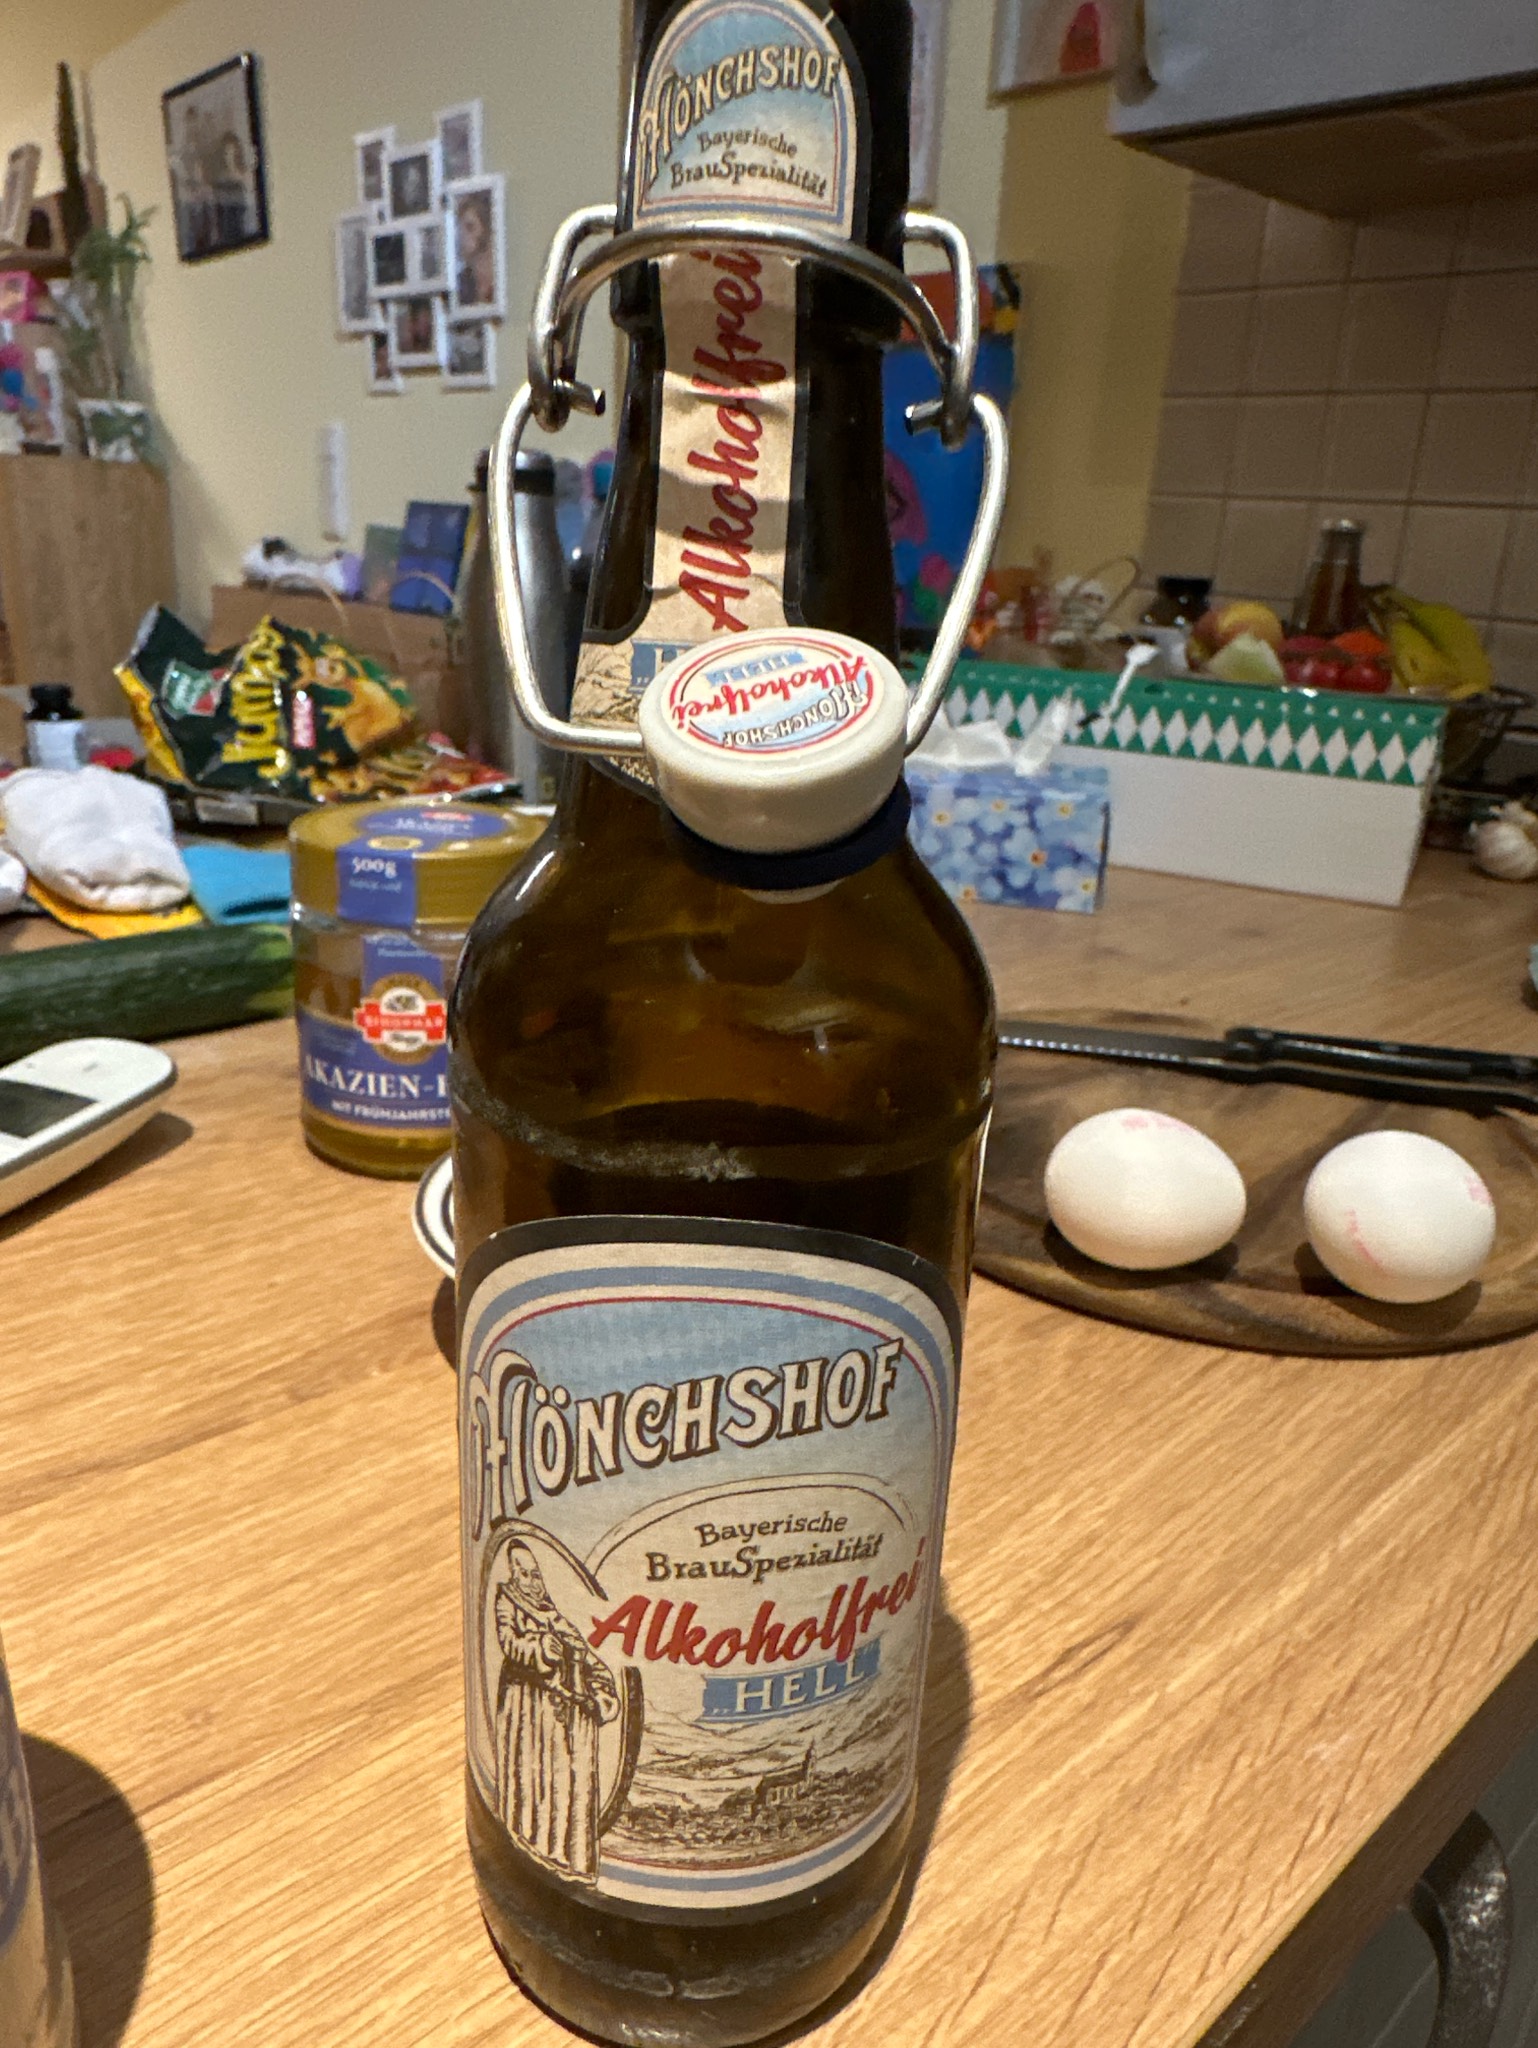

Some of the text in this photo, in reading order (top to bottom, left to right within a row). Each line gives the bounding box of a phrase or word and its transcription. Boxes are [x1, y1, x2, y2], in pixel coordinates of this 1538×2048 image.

[638, 43, 842, 191] MÖNCHSHOF
[697, 128, 798, 159] Bayerische
[670, 151, 827, 198] BrauSpezialität
[678, 247, 788, 633] Alkoholfrei
[671, 655, 868, 730] Alkoholfrei
[352, 856, 397, 879] 500g
[468, 1338, 904, 1541] MÖNCHSHOF
[645, 1533, 885, 1584] BrauSpezialität
[695, 1510, 848, 1547] Bayerische
[587, 1535, 926, 1668] Alkoholfrei
